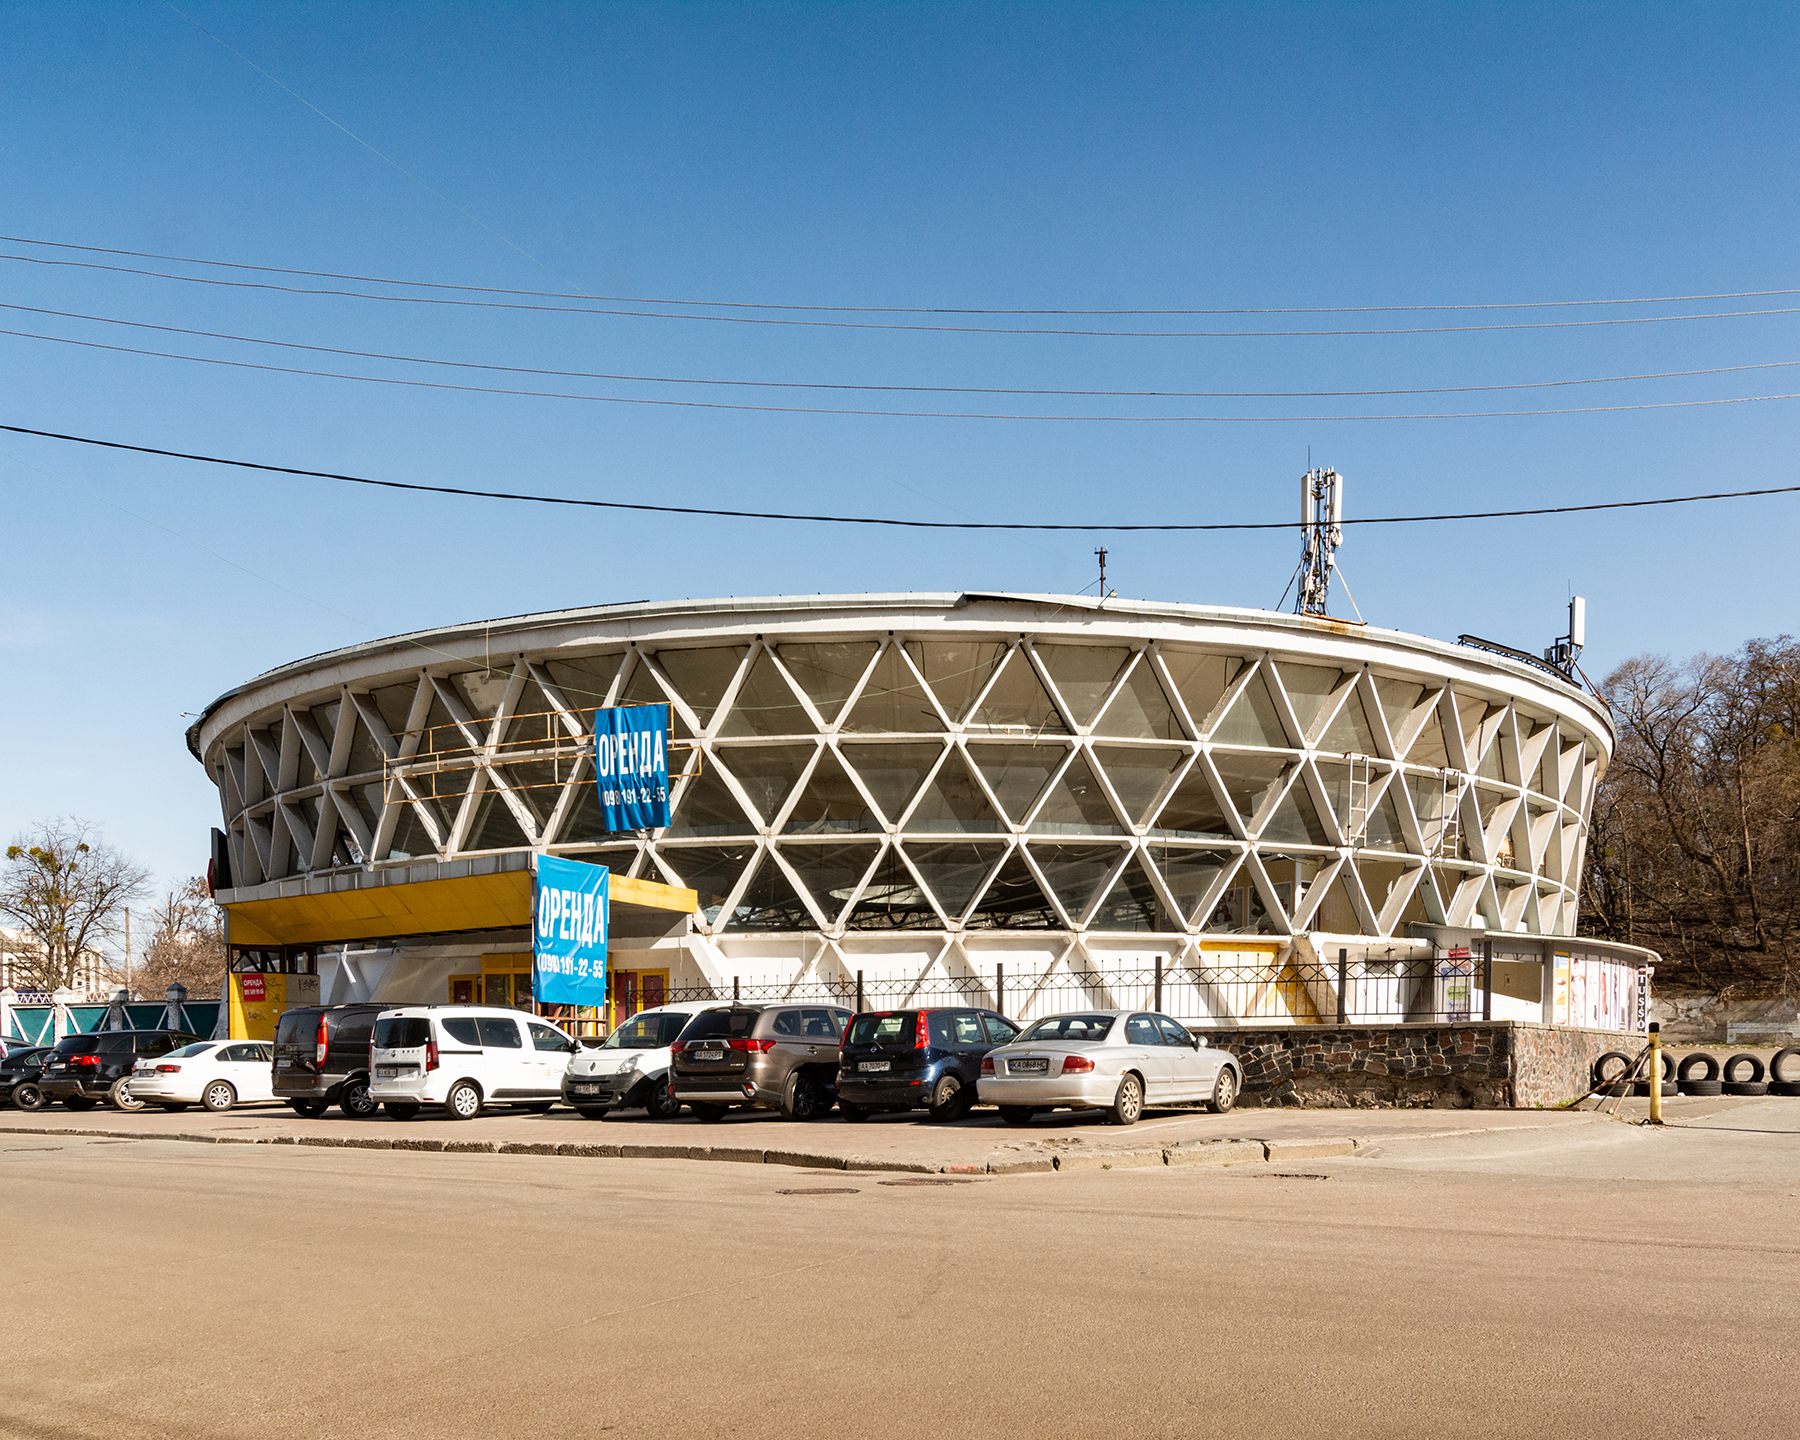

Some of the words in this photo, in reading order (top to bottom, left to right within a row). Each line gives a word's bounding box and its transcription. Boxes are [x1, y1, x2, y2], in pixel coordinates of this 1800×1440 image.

[599, 730, 665, 778] ОРЕНДА
[538, 885, 605, 948] ОРЕНДА
[243, 979, 263, 987] ОРЕНДА
[537, 952, 560, 975] (098)
[560, 956, 605, 979] 191-22-55
[1637, 974, 1646, 1028] TUSSO
